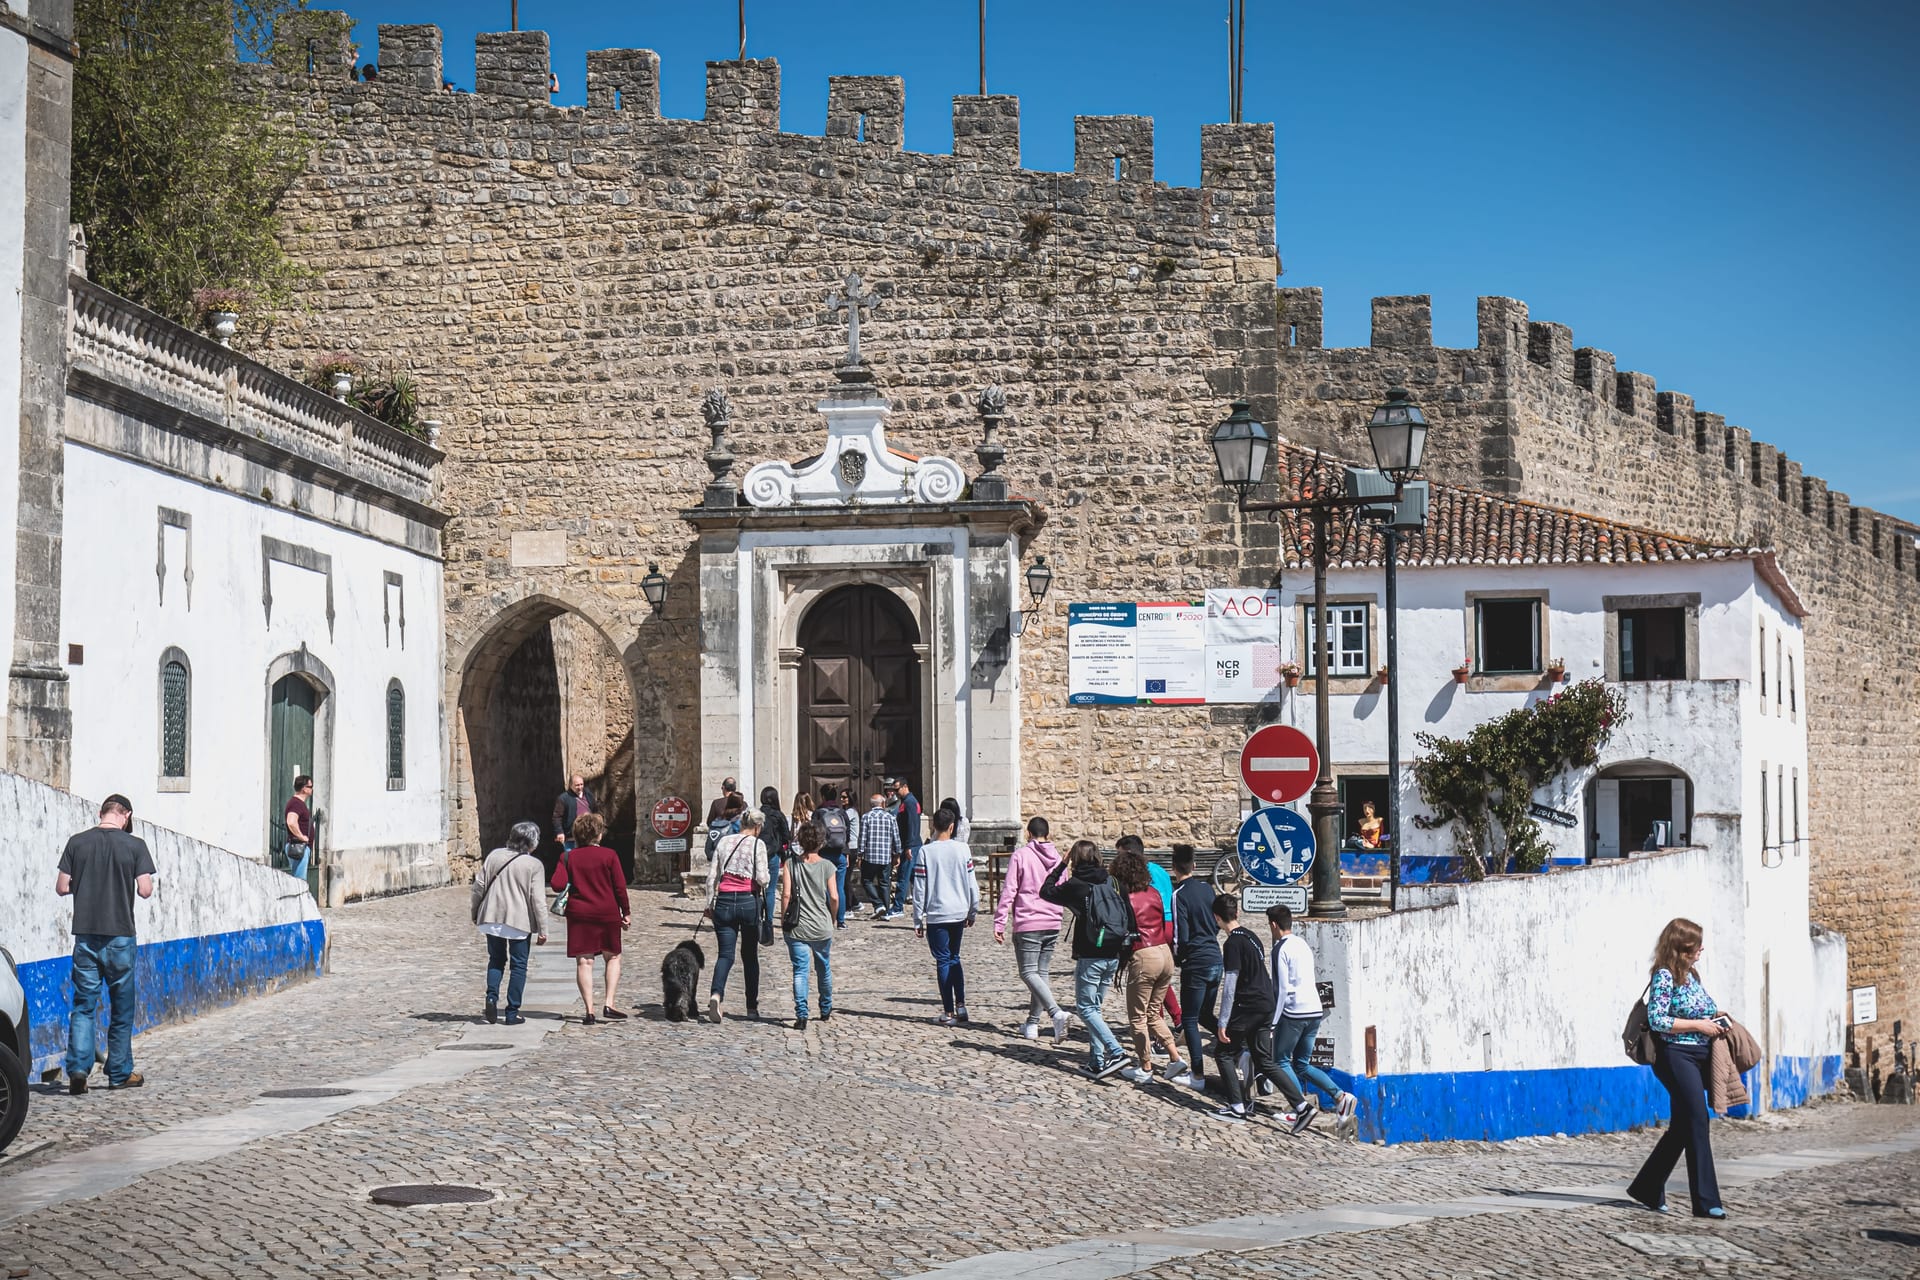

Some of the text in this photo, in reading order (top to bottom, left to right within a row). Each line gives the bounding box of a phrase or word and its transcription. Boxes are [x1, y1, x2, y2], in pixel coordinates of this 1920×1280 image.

[1222, 596, 1276, 616] AOF
[1138, 613, 1163, 621] CENTRO
[1216, 660, 1240, 669] NCR
[1225, 670, 1239, 678] EP
